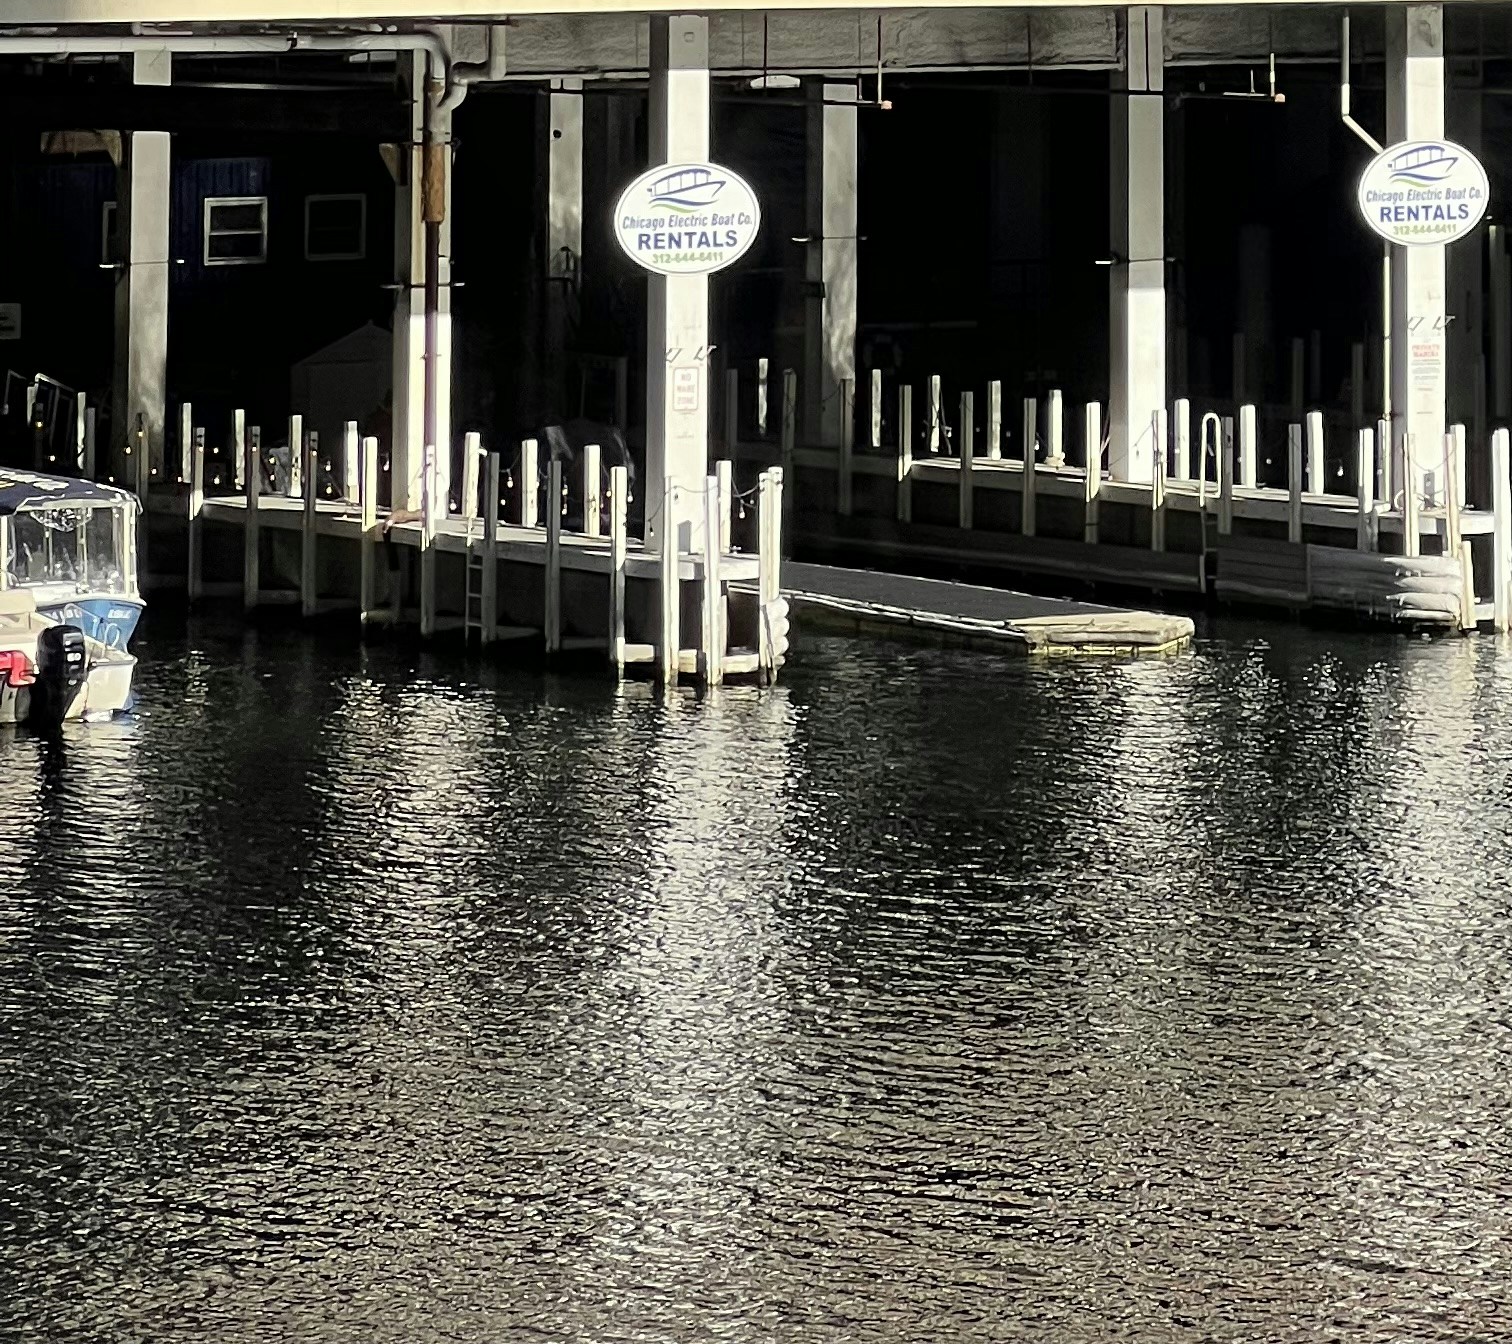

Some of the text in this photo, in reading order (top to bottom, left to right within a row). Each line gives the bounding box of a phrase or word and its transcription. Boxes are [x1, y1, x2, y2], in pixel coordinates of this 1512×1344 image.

[1366, 186, 1483, 205] Chicago Electric Boat Co.
[622, 212, 753, 231] Chicago Electric Boat Co.
[1380, 204, 1469, 223] RENTALS
[638, 230, 738, 251] RENTALS
